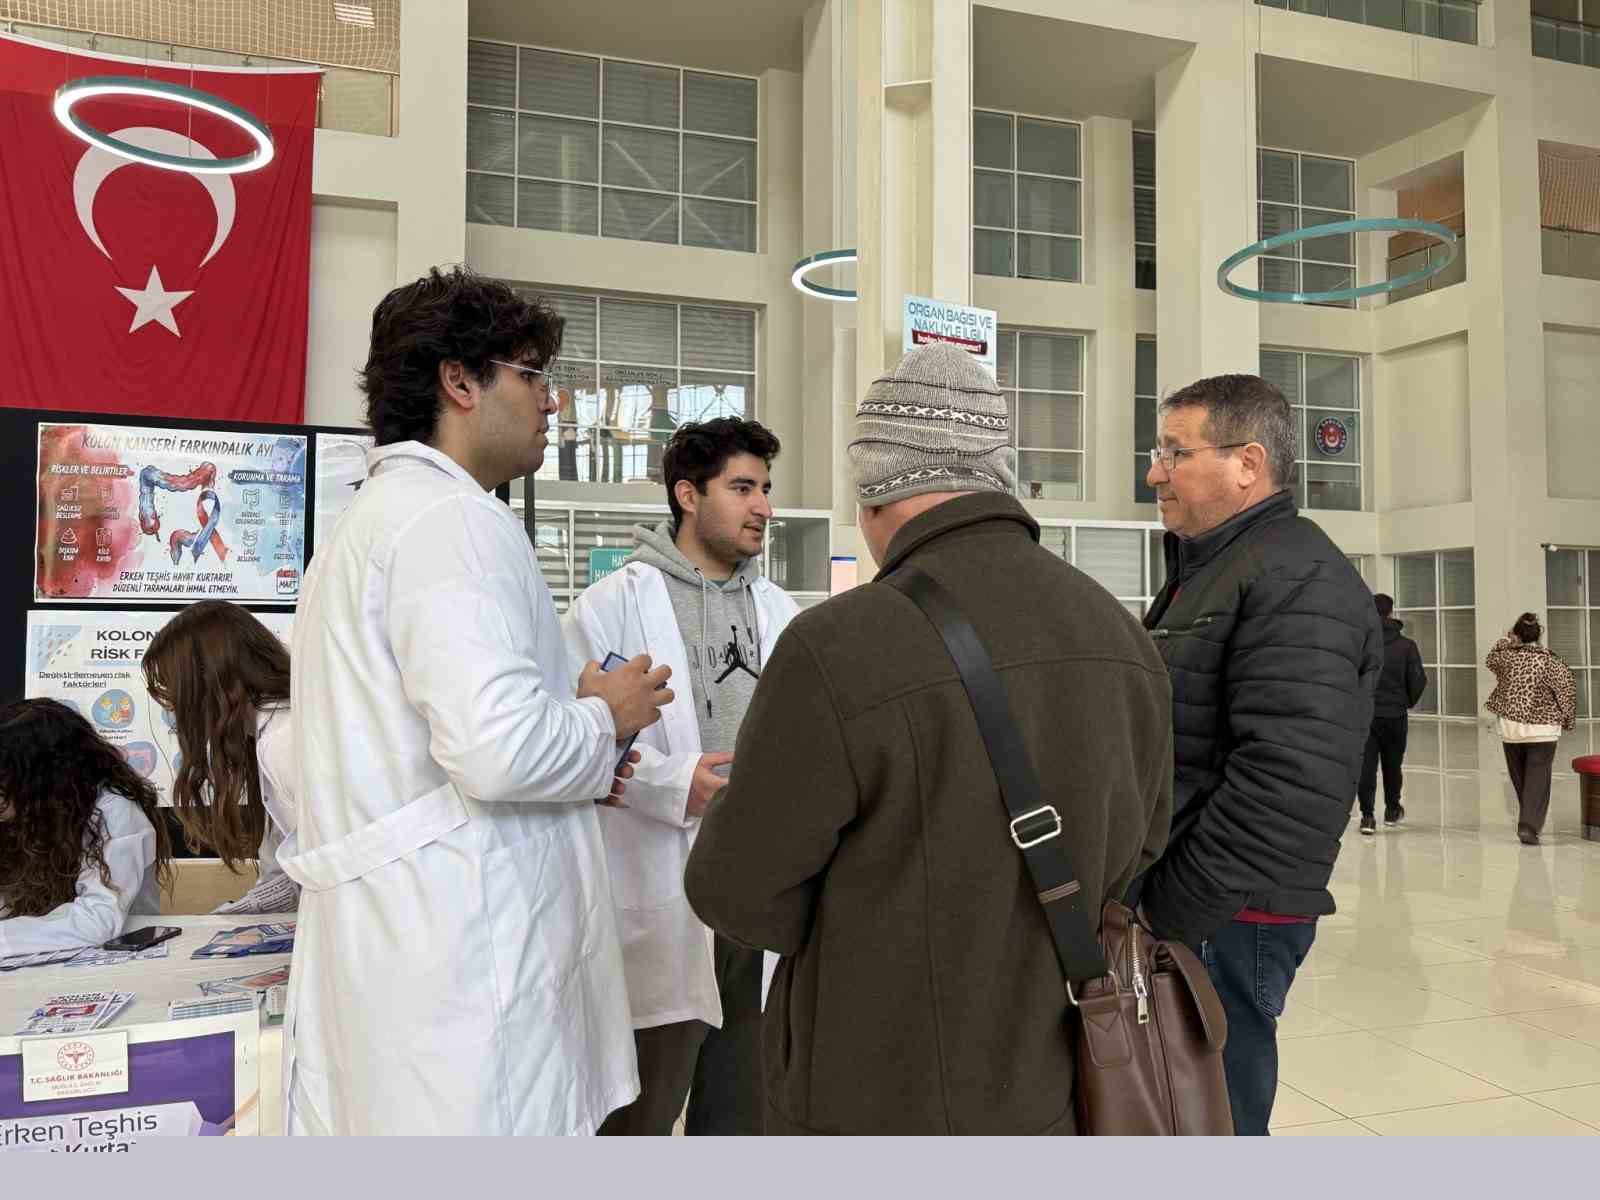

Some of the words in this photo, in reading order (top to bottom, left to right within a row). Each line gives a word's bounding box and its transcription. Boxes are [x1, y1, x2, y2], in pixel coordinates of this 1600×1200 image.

[908, 302, 945, 320] ORGAN
[979, 315, 992, 329] VE
[81, 432, 120, 449] KOLON
[127, 435, 177, 451] KANSERİ
[180, 439, 254, 456] FARKINDALIK
[256, 443, 274, 457] AYI
[80, 465, 90, 474] VE
[233, 472, 264, 481] KORUNMA
[120, 571, 144, 581] ERKEN
[146, 570, 170, 583] TEŞHİS
[173, 571, 194, 581] HAYAT
[196, 572, 232, 582] KURTARIR!
[113, 582, 141, 592] DÜZENLİ
[143, 583, 184, 593] TARAMALARI
[186, 583, 206, 593] İHMAL
[96, 630, 160, 641] KOLON
[91, 646, 130, 660] RİSK
[77, 1069, 122, 1080] BAKANLIĞI
[0, 1123, 64, 1146] rken
[71, 1111, 157, 1141] Teşhis
